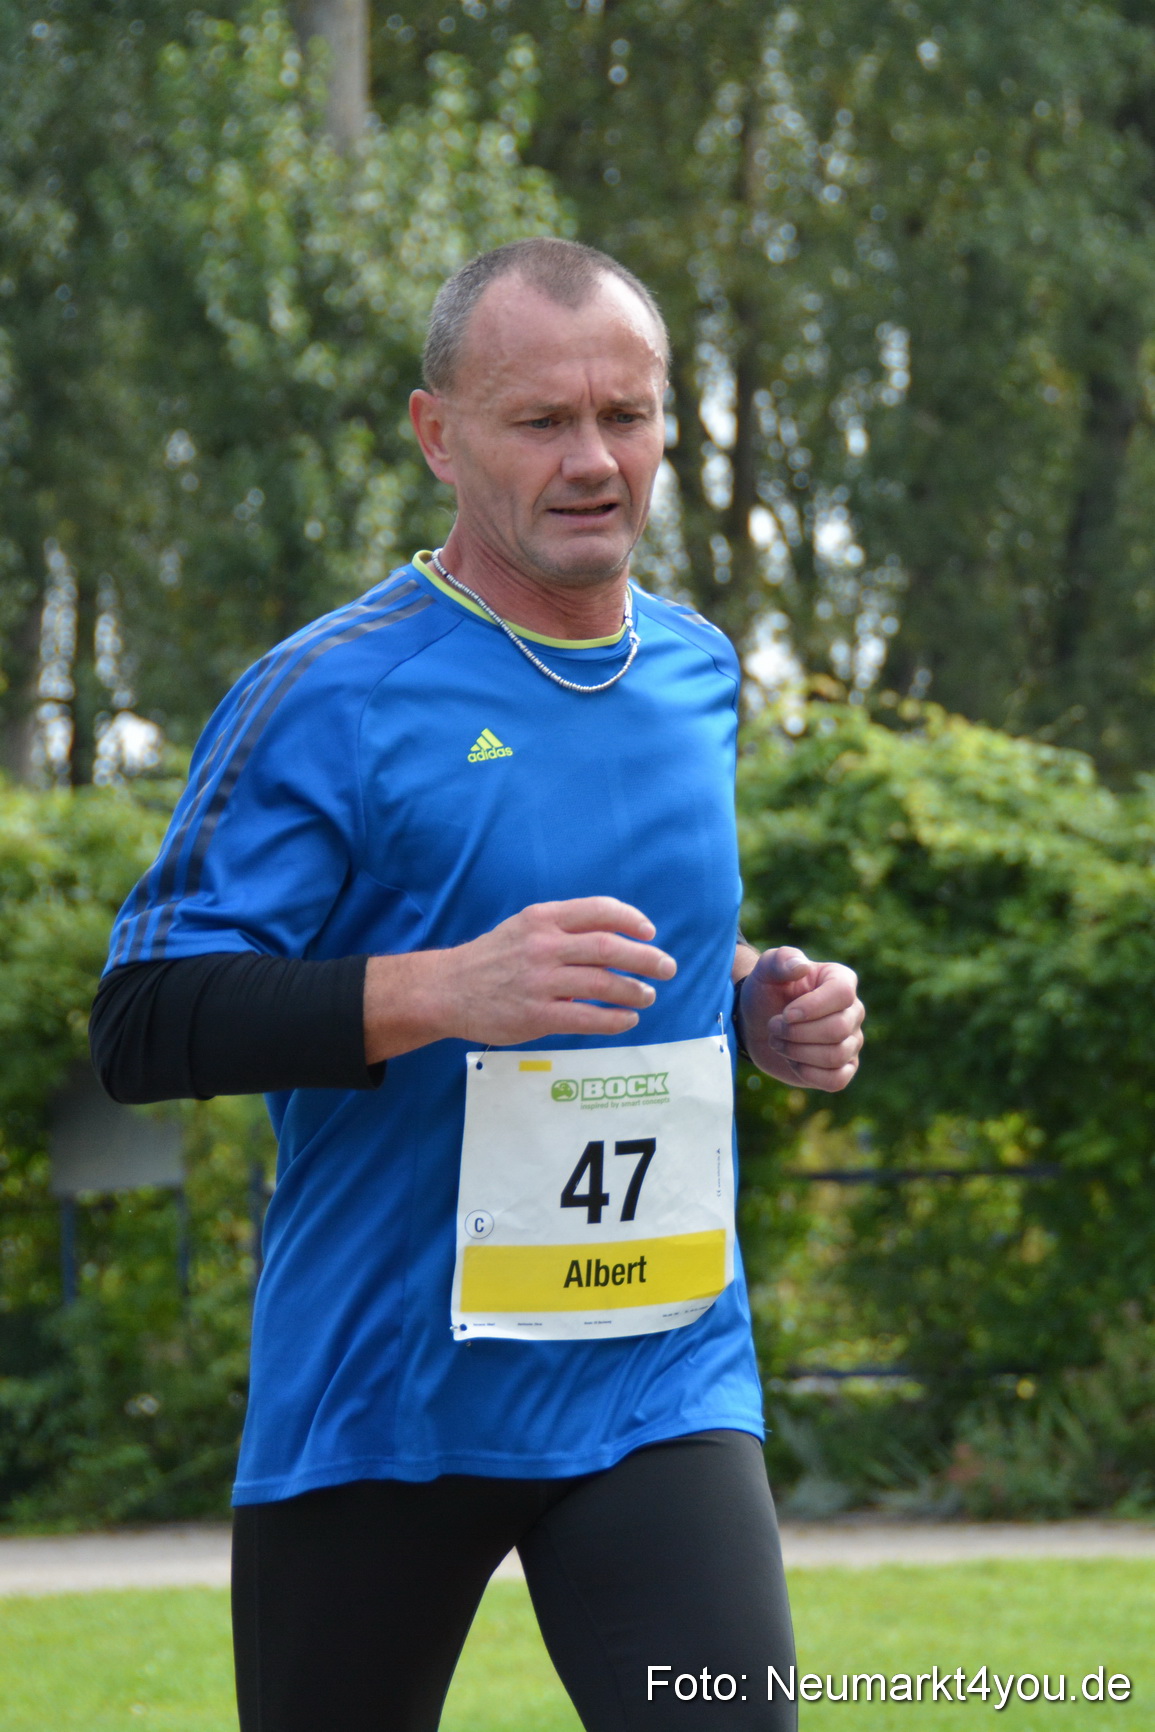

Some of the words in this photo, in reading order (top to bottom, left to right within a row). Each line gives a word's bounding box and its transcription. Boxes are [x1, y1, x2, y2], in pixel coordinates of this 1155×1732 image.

[467, 747, 513, 762] adidas
[581, 1072, 670, 1101] BOCK
[580, 1102, 609, 1110] inspired
[611, 1101, 619, 1109] by
[642, 1097, 670, 1105] concepts
[560, 1137, 657, 1224] 47
[474, 1217, 485, 1233] C
[563, 1255, 647, 1289] Albert
